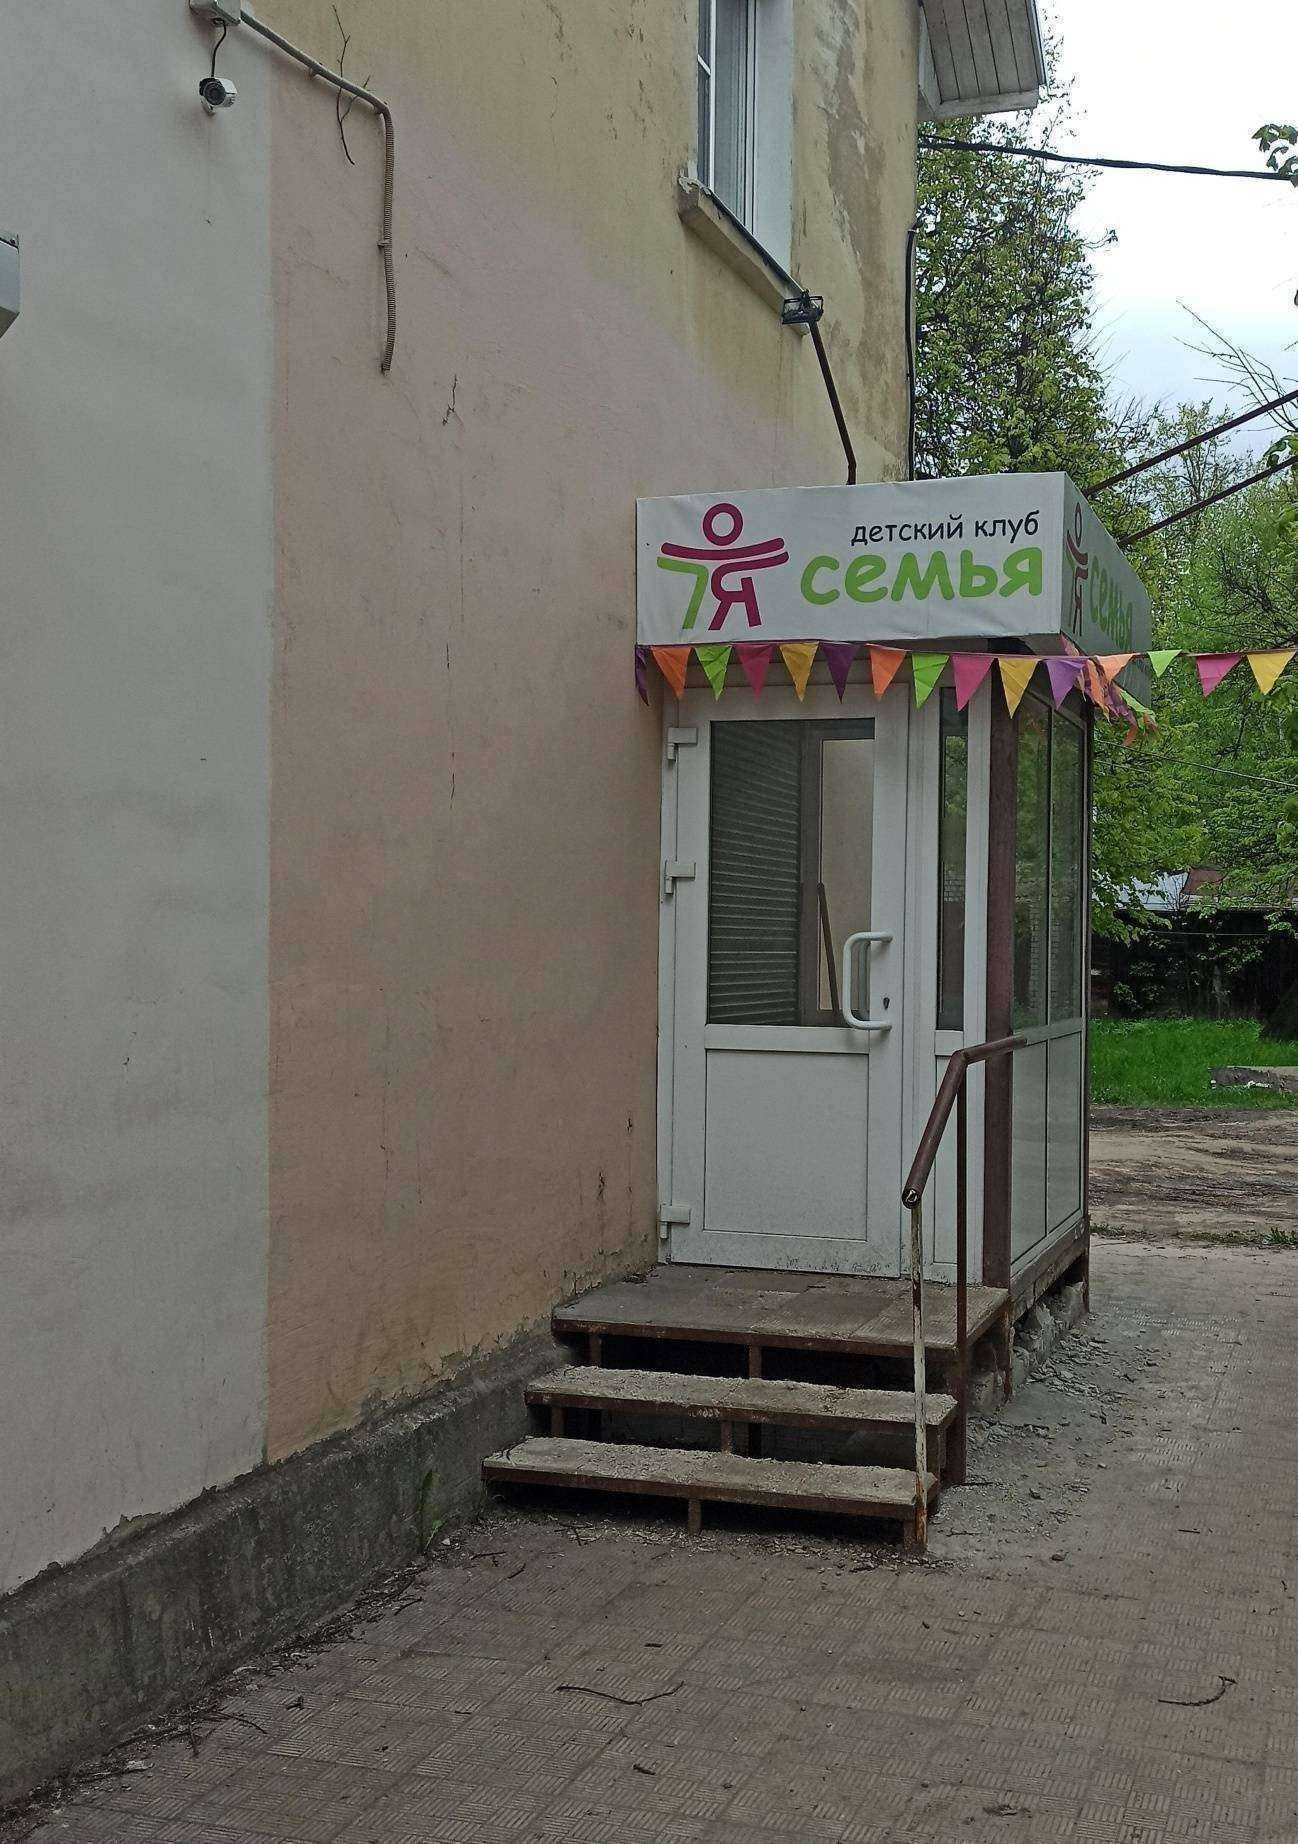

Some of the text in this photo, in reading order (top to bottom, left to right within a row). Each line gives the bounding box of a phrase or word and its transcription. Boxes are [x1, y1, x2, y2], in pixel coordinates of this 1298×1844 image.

[850, 509, 1041, 547] детский клуб
[800, 547, 1043, 605] семья
